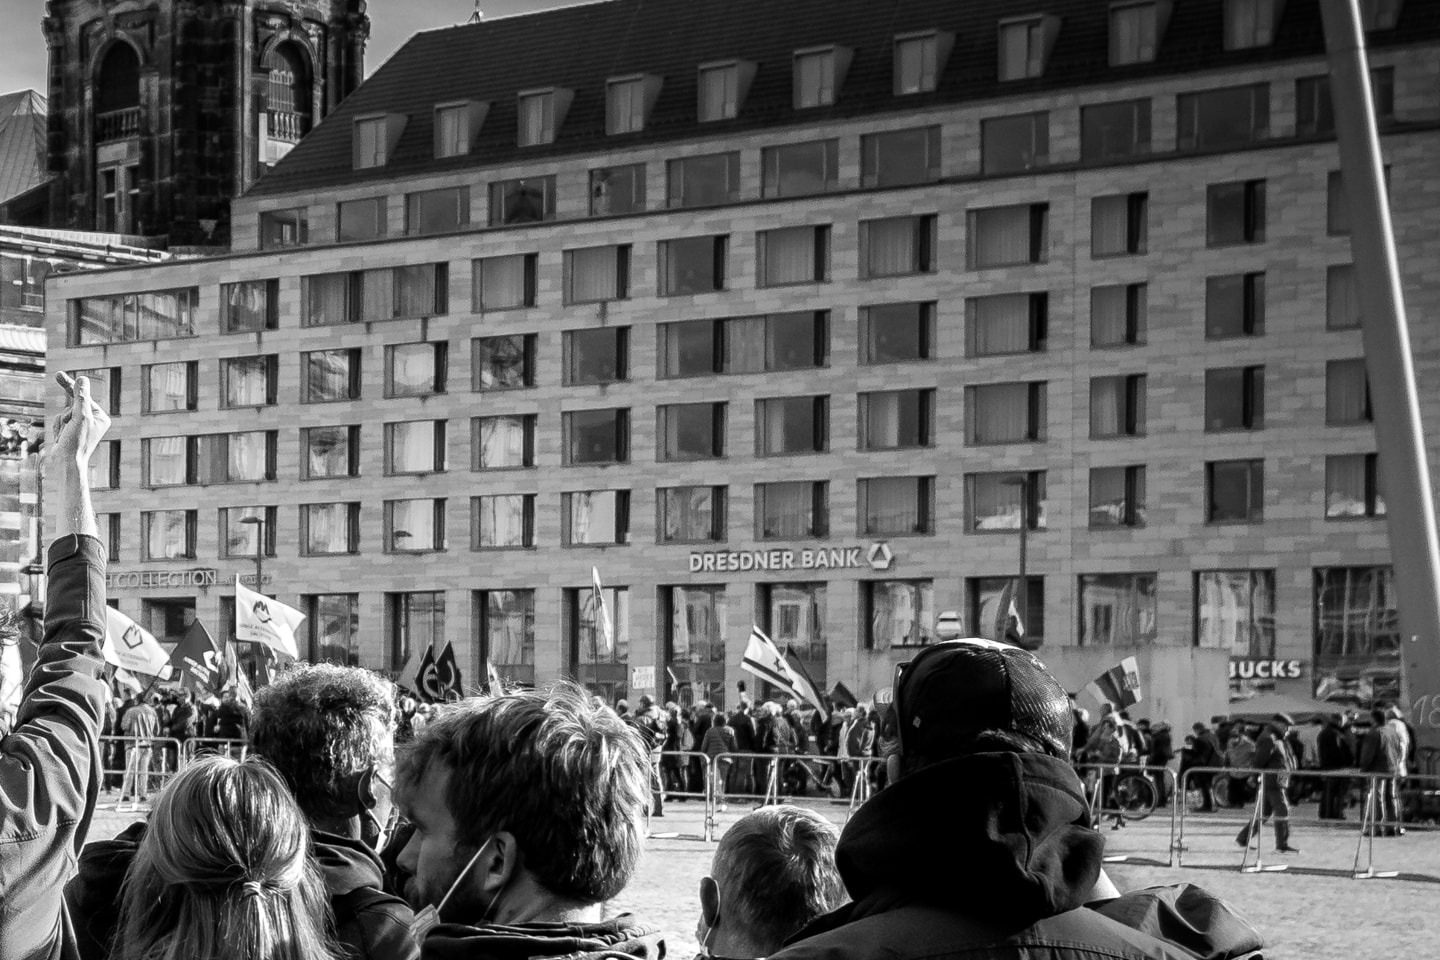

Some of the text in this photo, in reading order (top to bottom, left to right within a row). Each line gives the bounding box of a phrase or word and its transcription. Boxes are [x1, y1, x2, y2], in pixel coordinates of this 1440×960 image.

[689, 549, 860, 572] DRESDNER BANK
[116, 570, 217, 587] COLLECTION
